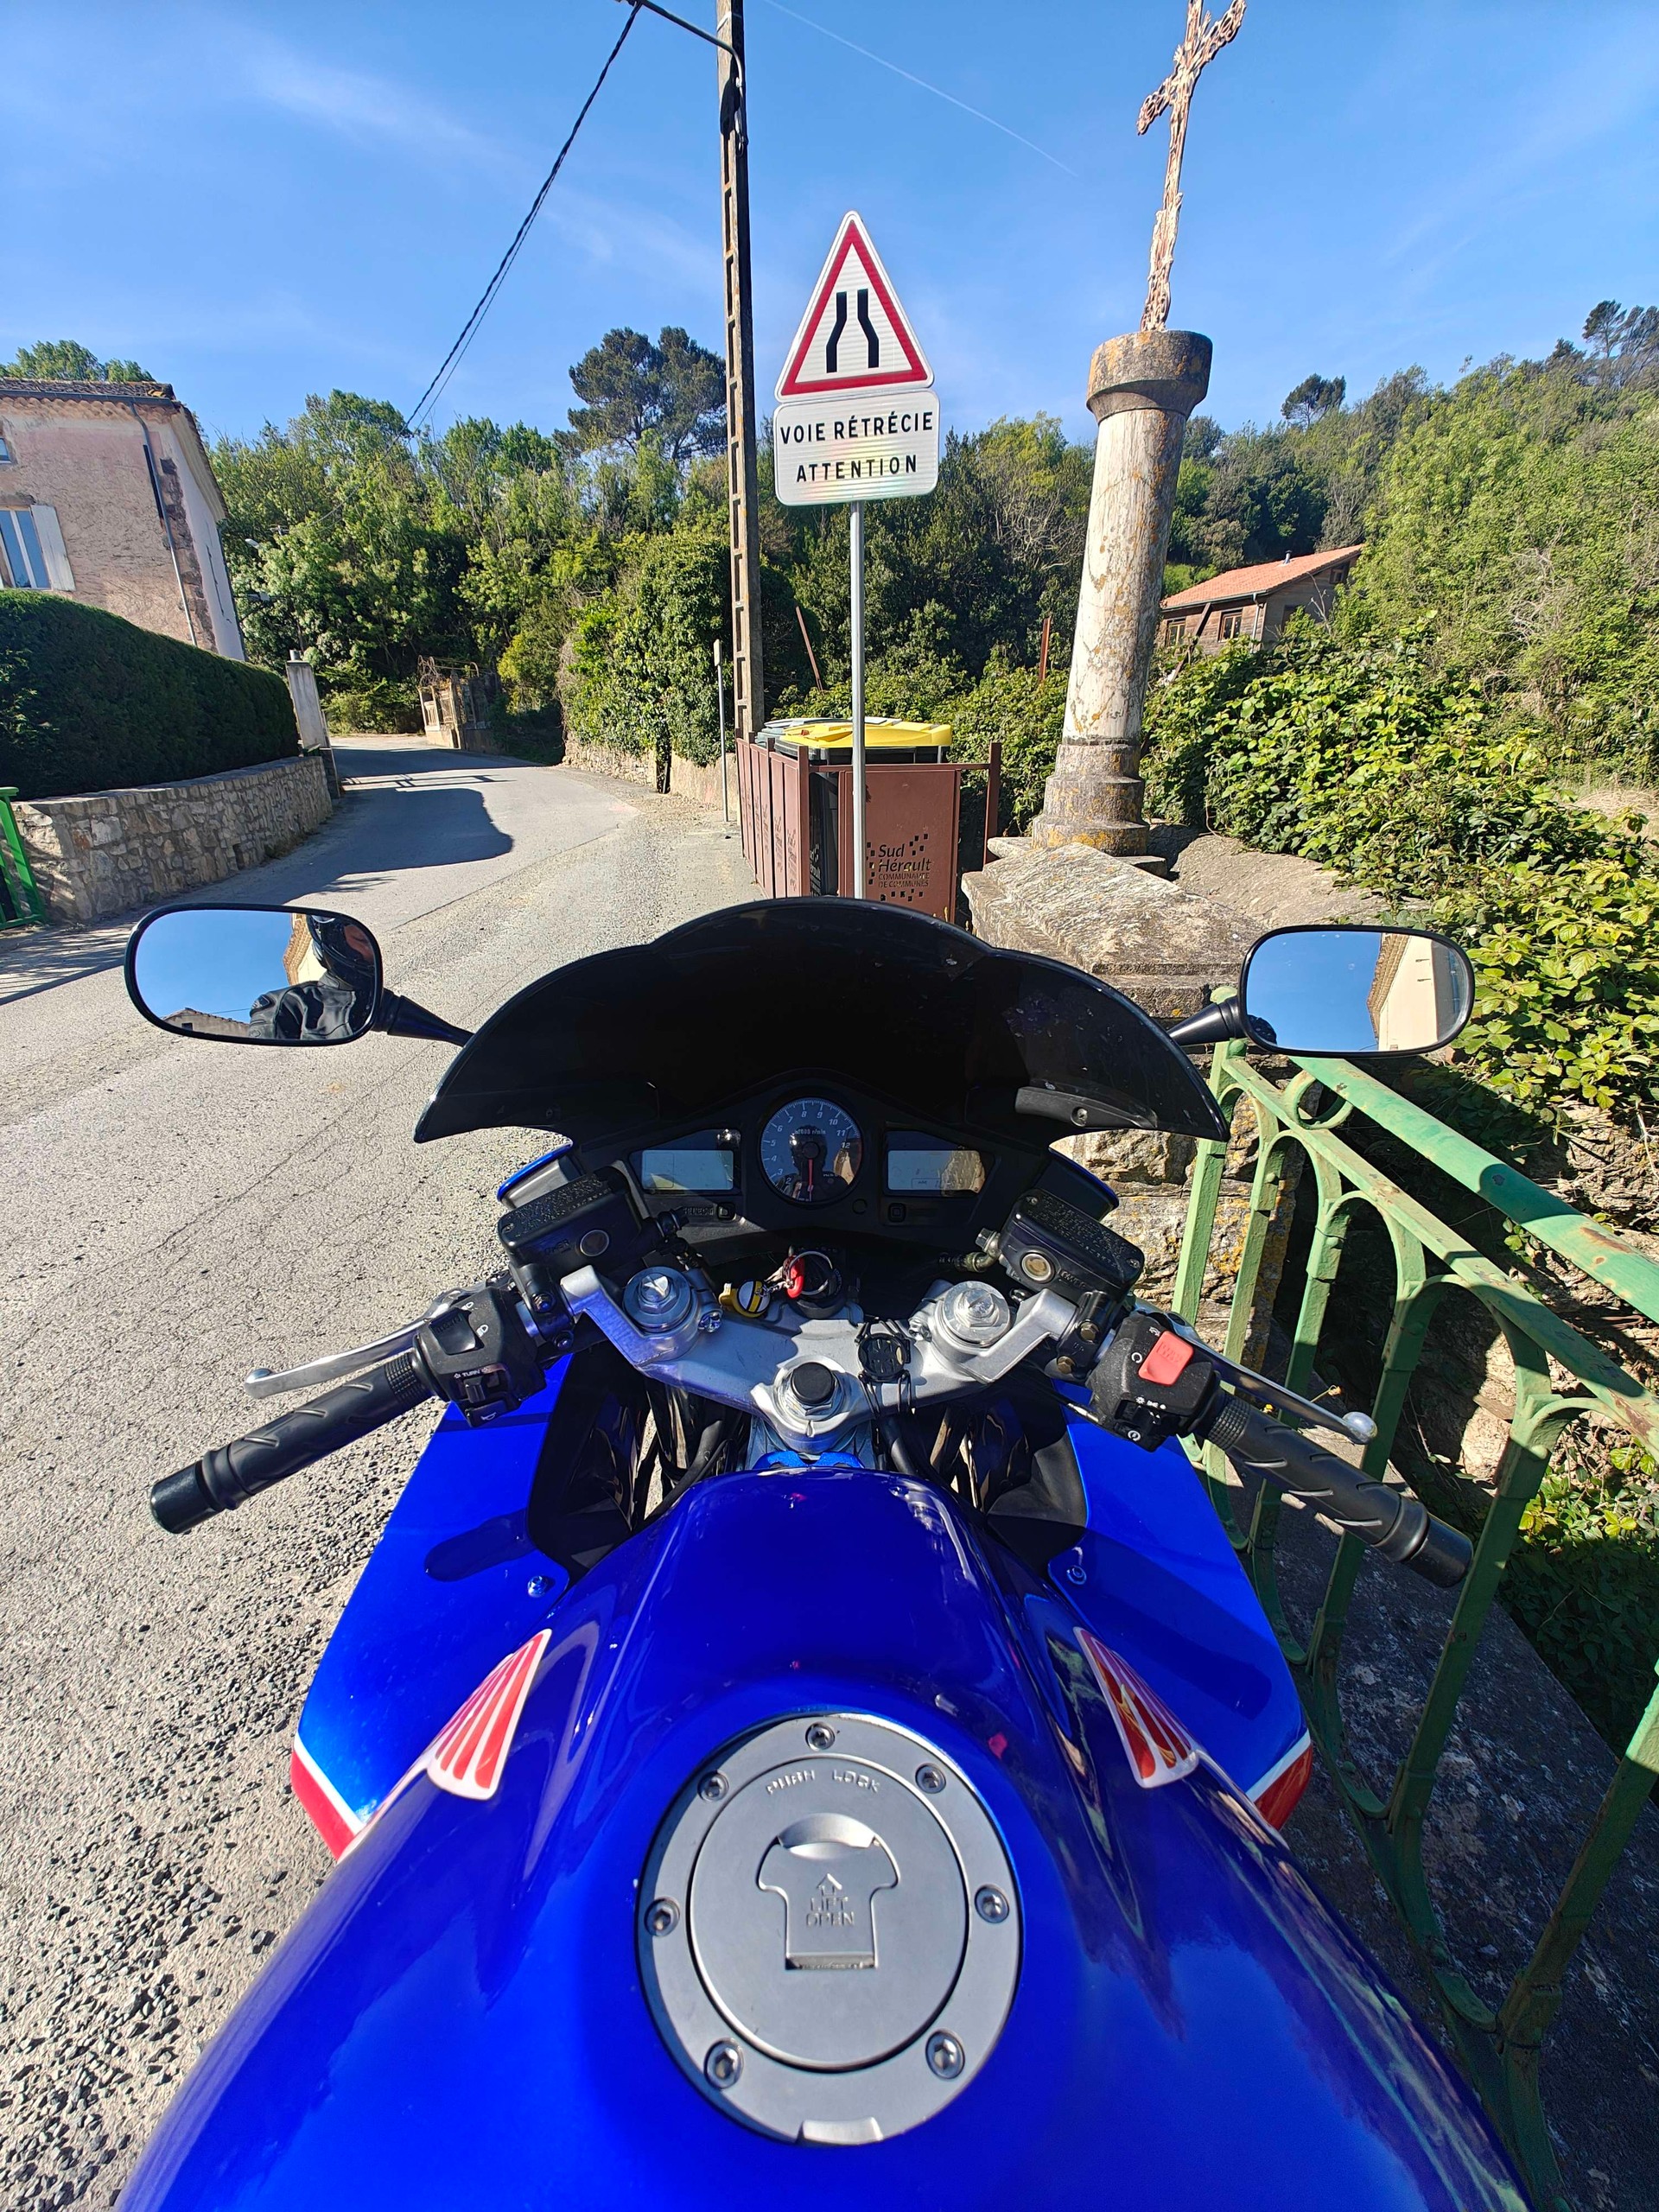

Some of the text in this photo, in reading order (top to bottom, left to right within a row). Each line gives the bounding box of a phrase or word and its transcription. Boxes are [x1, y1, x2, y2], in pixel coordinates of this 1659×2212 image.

[780, 411, 933, 444] VOIE RÉTRÉCIE
[796, 454, 917, 482] ATTENTION
[878, 843, 906, 858] Sud
[878, 858, 932, 873] Hérault
[766, 1769, 880, 1795] PUSH LOCK
[810, 1896, 849, 1911] LIFT
[805, 1910, 855, 1928] OPEN
